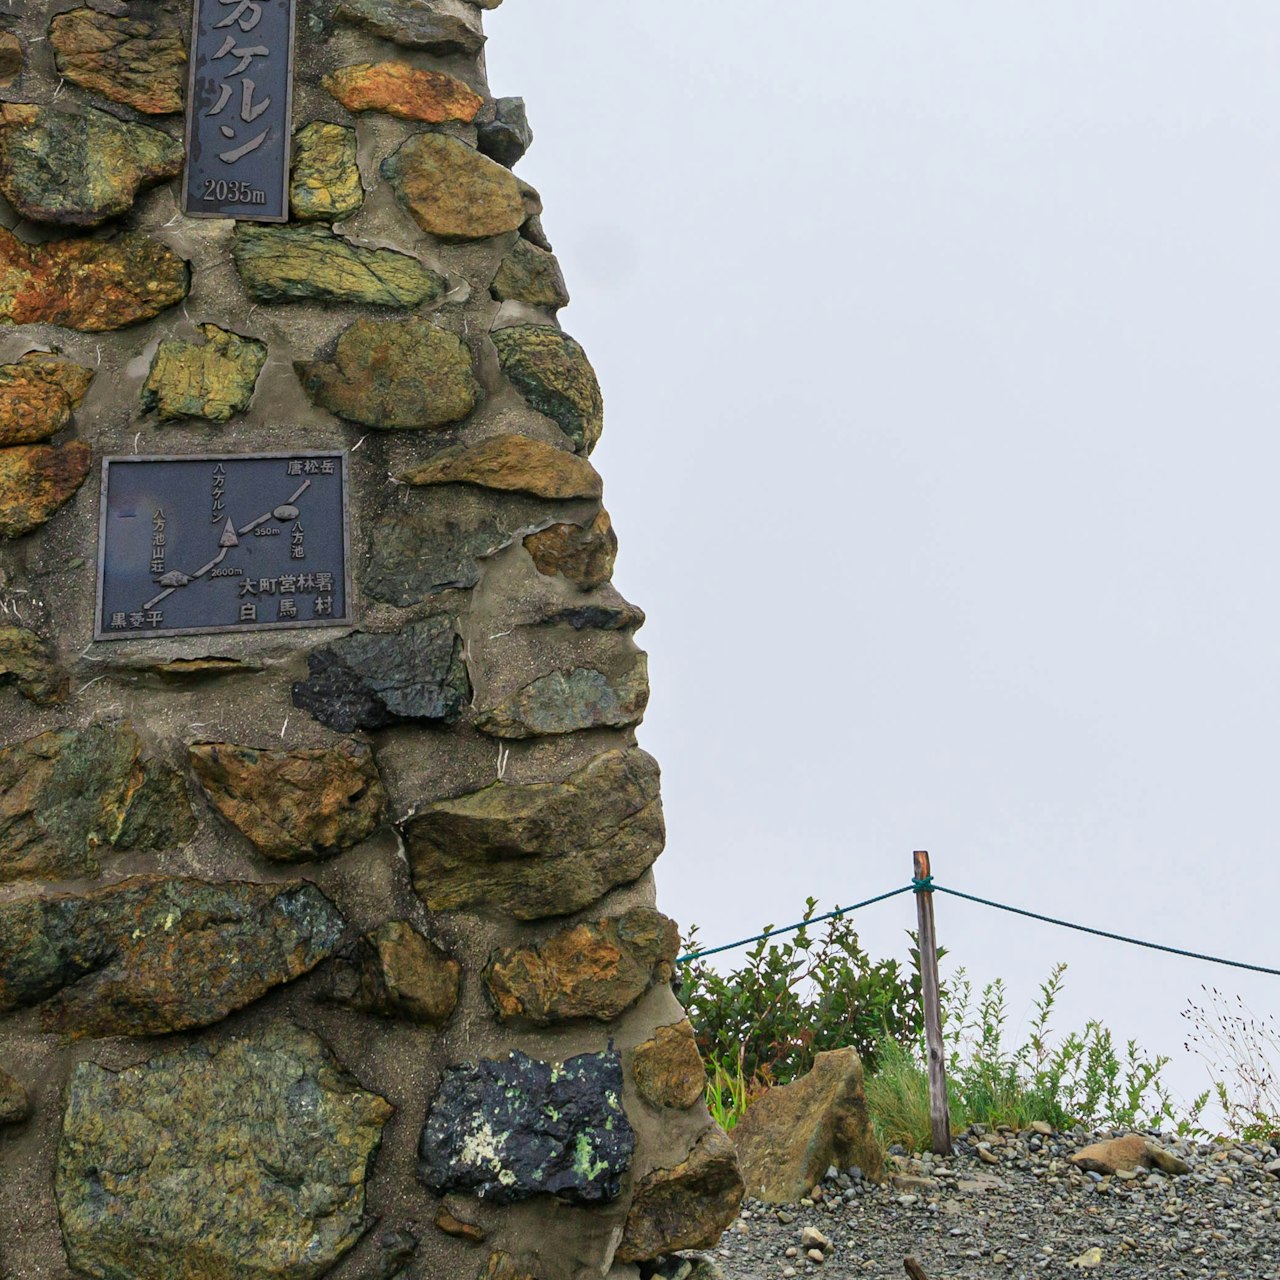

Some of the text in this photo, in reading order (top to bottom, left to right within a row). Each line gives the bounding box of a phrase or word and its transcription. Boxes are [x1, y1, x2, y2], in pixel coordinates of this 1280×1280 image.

[203, 178, 266, 205] 2035m
[287, 460, 335, 476] 唐松岳
[211, 463, 225, 523] 八方ケルン
[150, 508, 166, 573] 八方池山荘
[254, 527, 280, 536] 350m
[291, 522, 305, 558] 八方池
[239, 572, 333, 596] 大町営林署
[110, 610, 164, 629] 黒菱平
